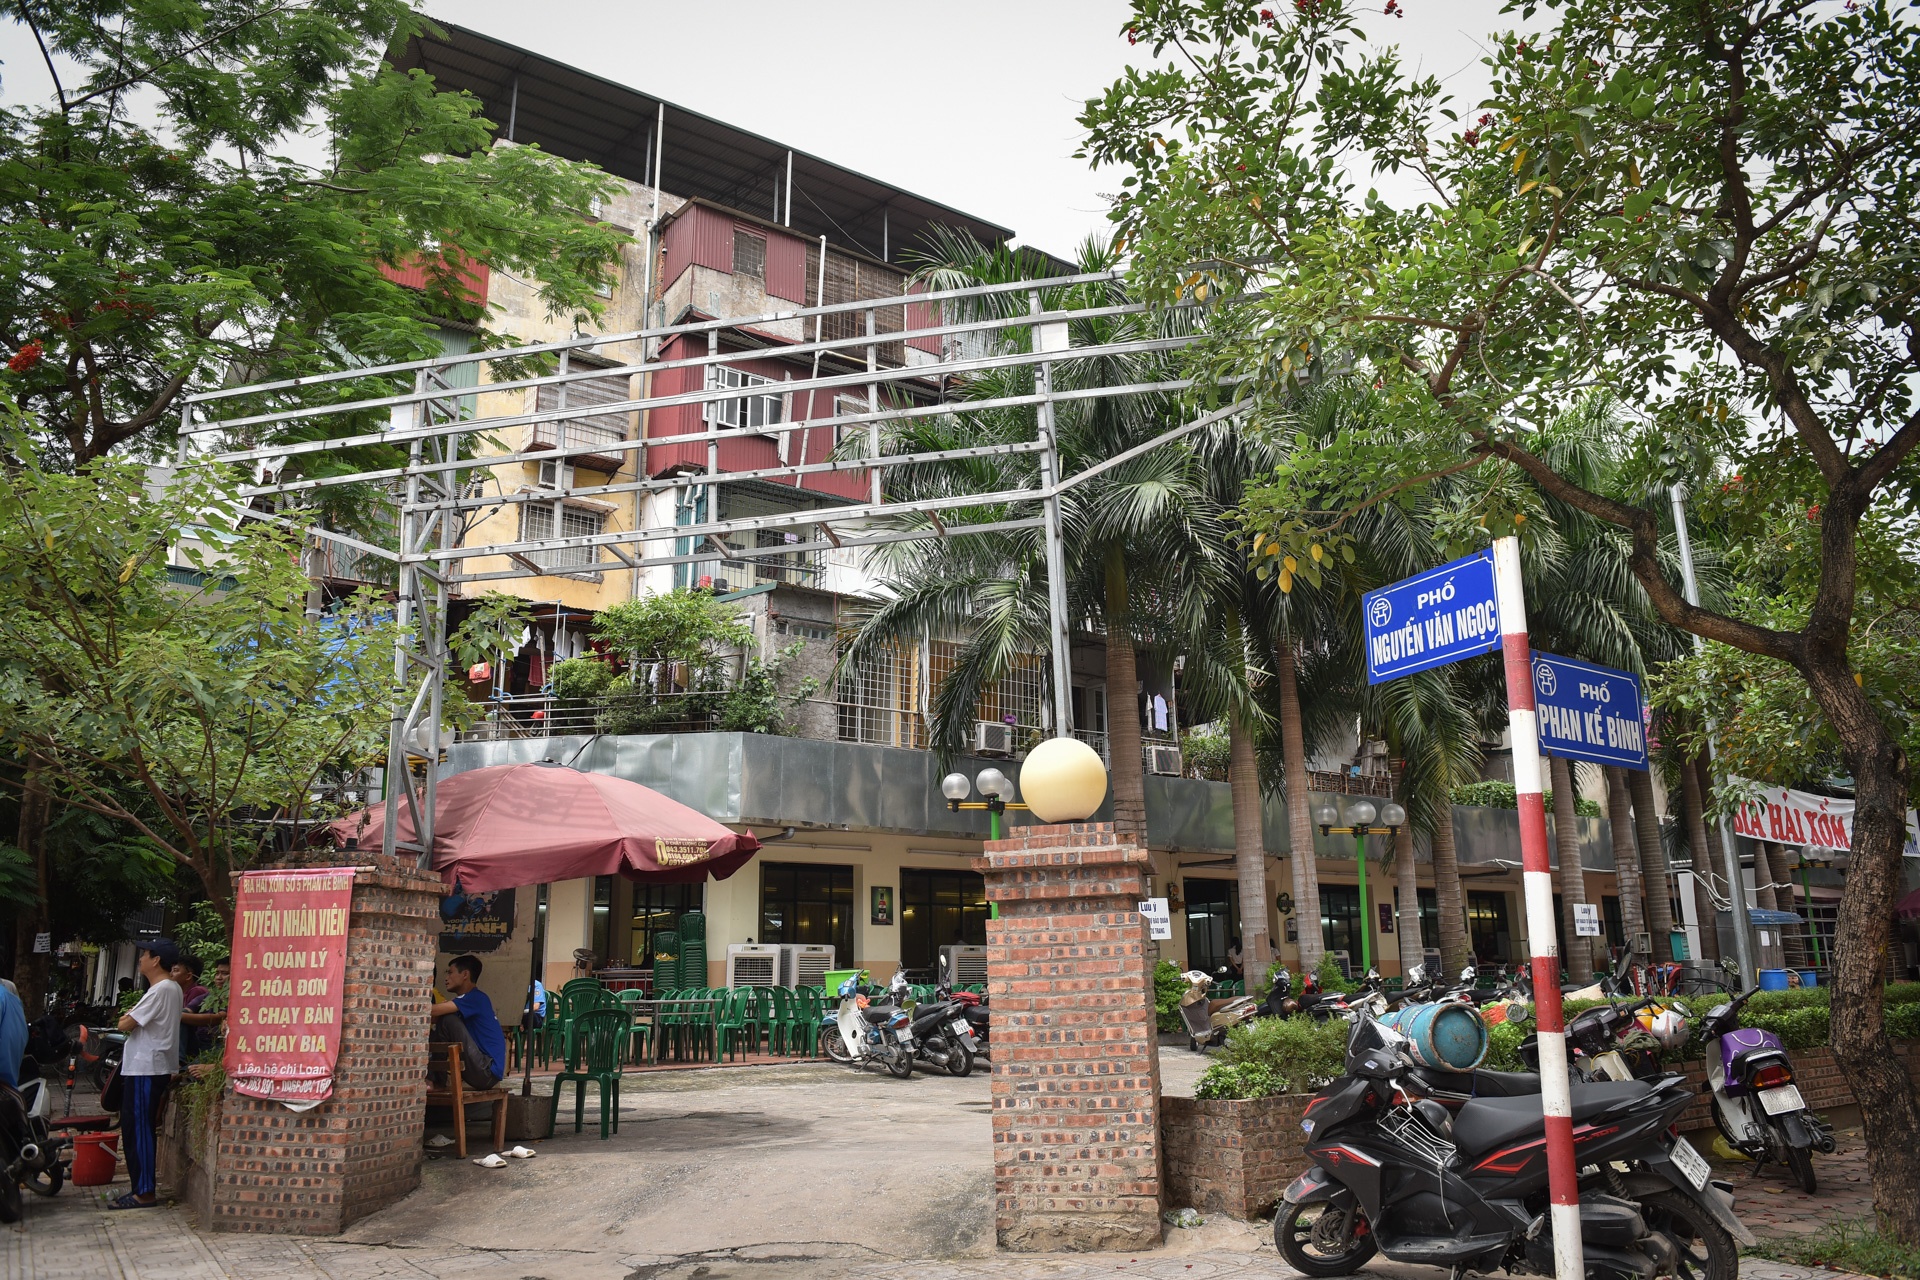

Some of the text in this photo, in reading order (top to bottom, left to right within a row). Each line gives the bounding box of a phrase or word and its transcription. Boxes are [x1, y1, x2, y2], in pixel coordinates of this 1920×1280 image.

[1417, 576, 1455, 610] PHỐ
[1373, 599, 1496, 666] NGUYỄN VĂN NGỌC
[1579, 681, 1611, 703] PHỐ
[1538, 703, 1642, 752] PHAN KẾ BÍNH
[244, 878, 255, 894] BIA
[297, 877, 302, 892] 5
[302, 876, 321, 892] PHAN
[243, 899, 346, 938] TUYỂN NHÂN VIÊN
[1140, 902, 1152, 912] Lưu
[244, 944, 328, 970] 1. QUẢN LÝ
[241, 976, 328, 997] 2. HÓA ĐƠN
[239, 1003, 334, 1028] 3. CHẠY BÀN
[236, 1035, 251, 1053] 4.
[300, 1035, 326, 1053] BIA
[237, 1063, 261, 1075] Liên
[280, 1064, 297, 1077] chị
[299, 1064, 326, 1075] Loan
